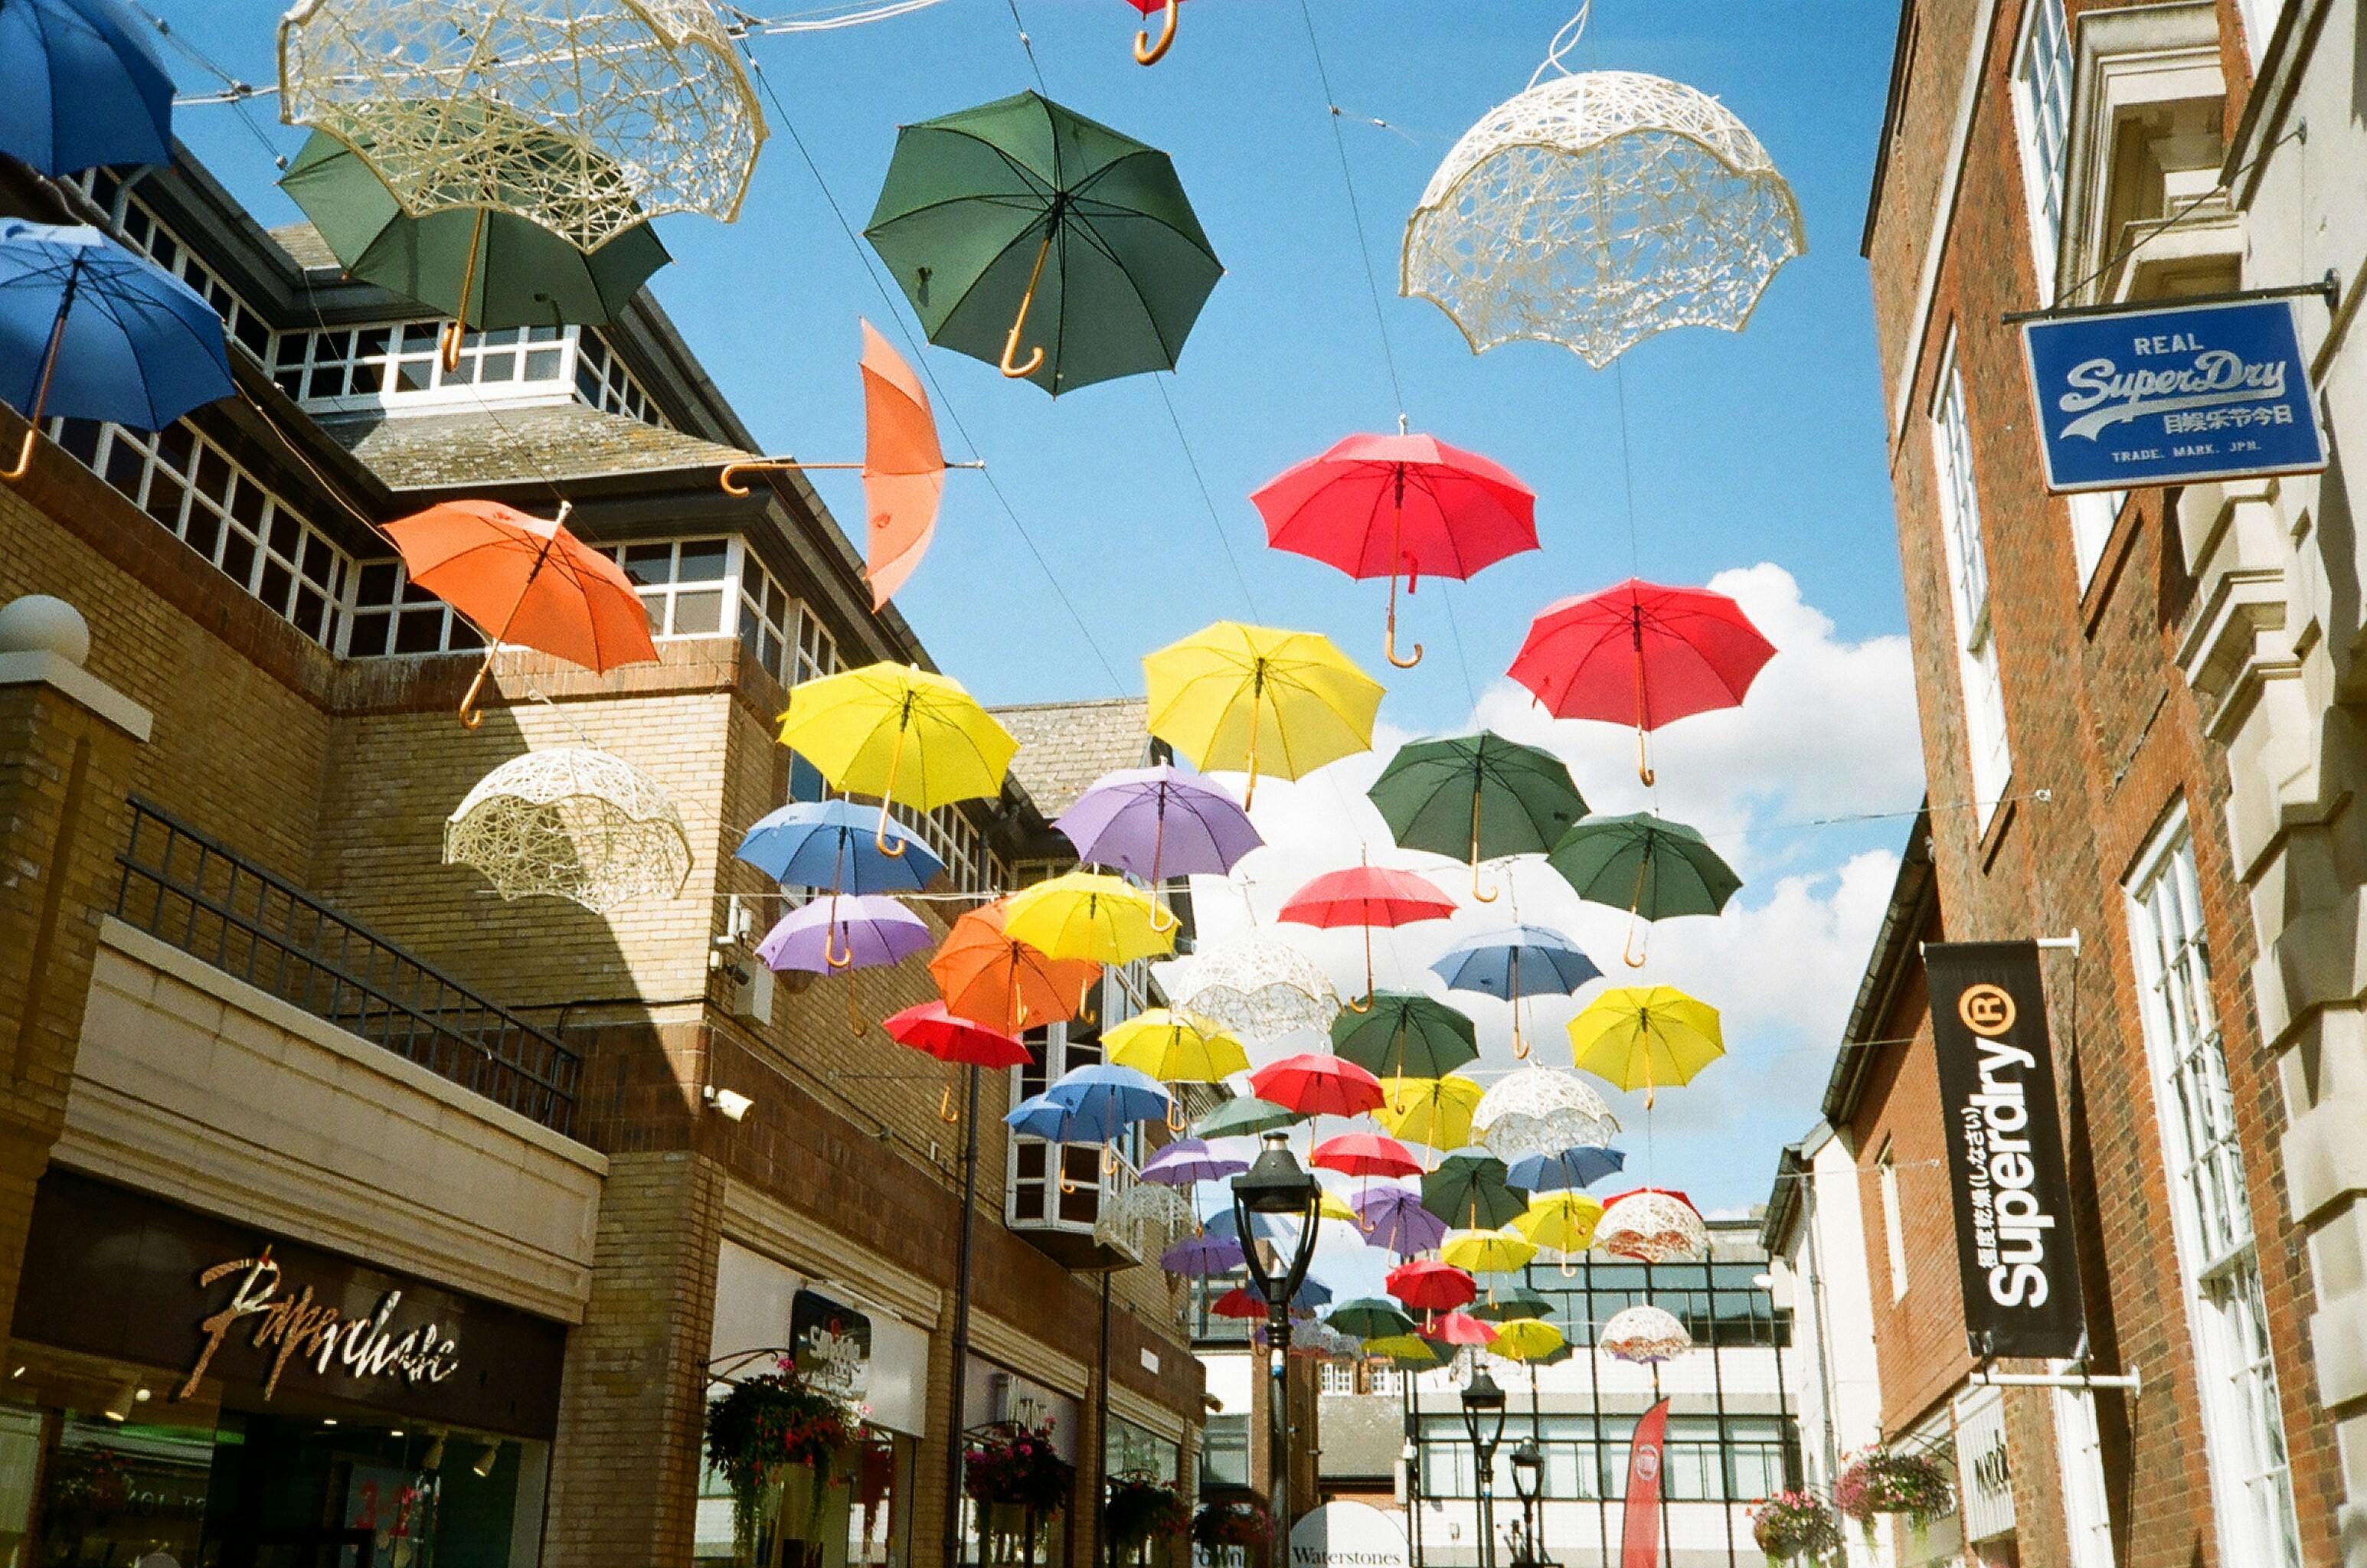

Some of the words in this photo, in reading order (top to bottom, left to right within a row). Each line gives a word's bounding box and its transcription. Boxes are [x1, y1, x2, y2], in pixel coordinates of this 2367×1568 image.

[2133, 332, 2205, 356] REAL
[1970, 1037, 2055, 1308] Superdry
[178, 1243, 458, 1403] Paperchase
[1292, 1546, 1401, 1566] Waterstones
